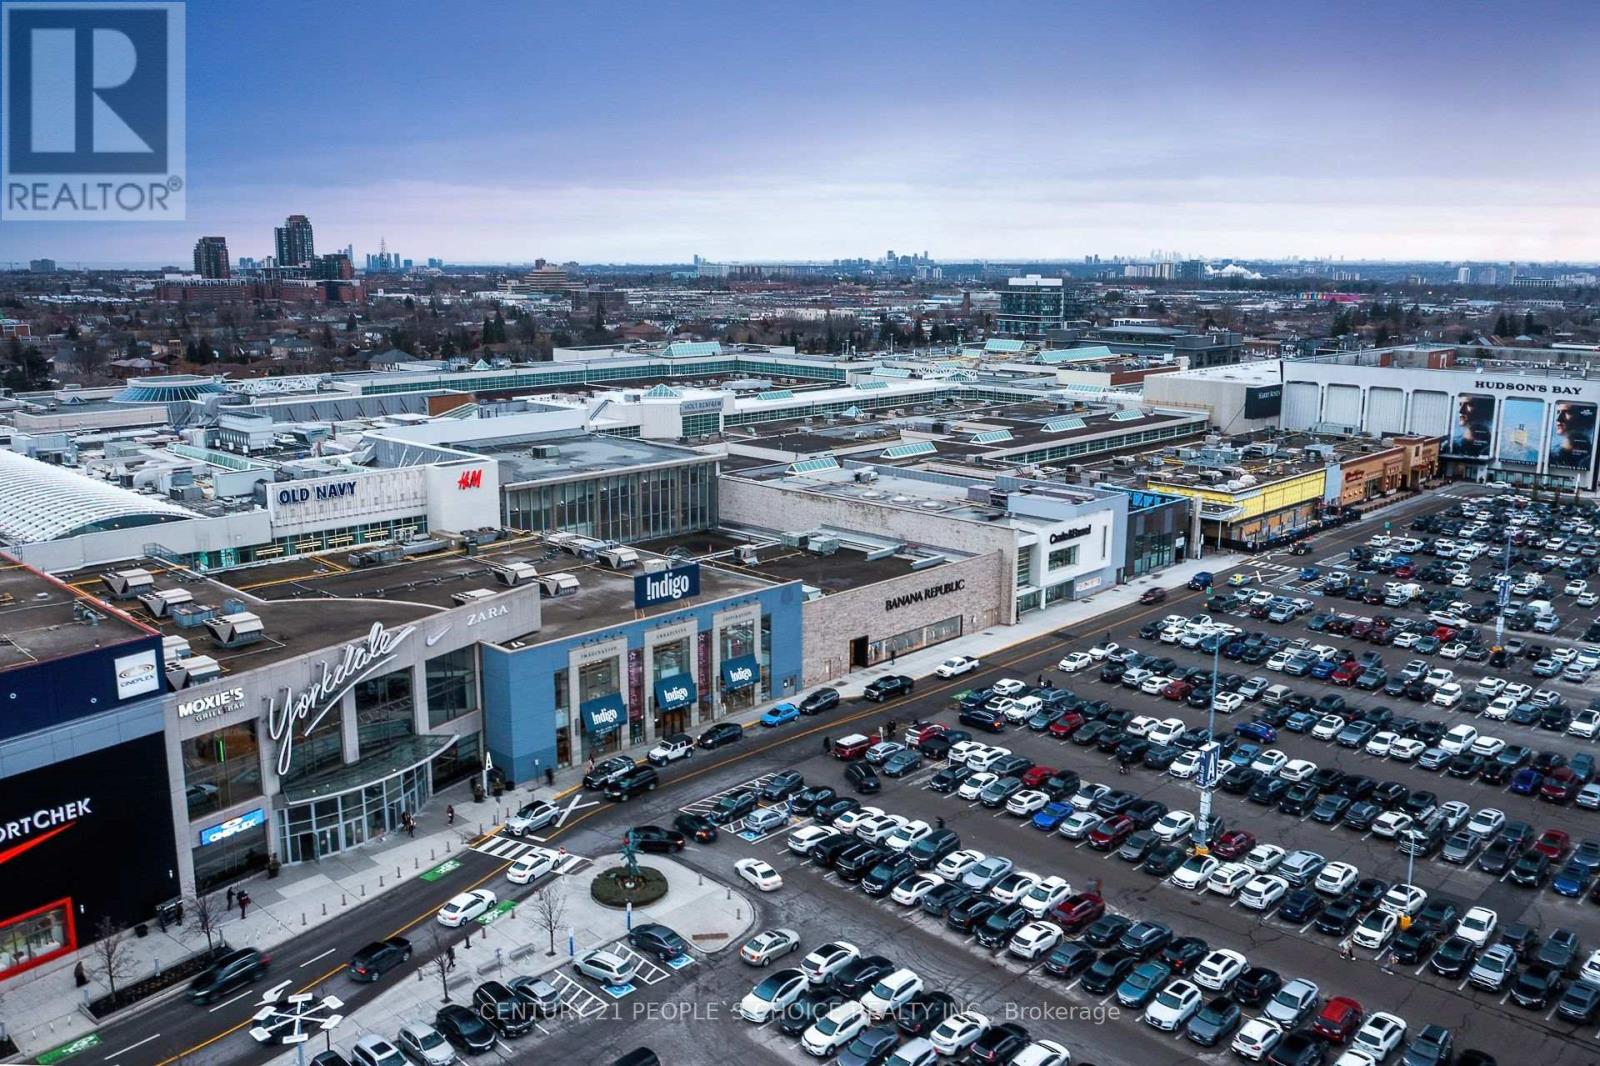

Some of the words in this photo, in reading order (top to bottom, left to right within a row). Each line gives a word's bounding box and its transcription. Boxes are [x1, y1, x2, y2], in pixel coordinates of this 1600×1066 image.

[1475, 380, 1548, 393] HUDSON'S
[1552, 386, 1582, 395] BAY
[458, 470, 482, 490] H&M
[279, 488, 310, 505] OLD
[316, 481, 356, 500] NAVY
[885, 591, 922, 612] BANANA
[924, 579, 965, 600] REPUBLIC
[467, 605, 508, 626] ZARA
[178, 688, 245, 718] MOXIE'S
[270, 621, 416, 776] Yorkdale
